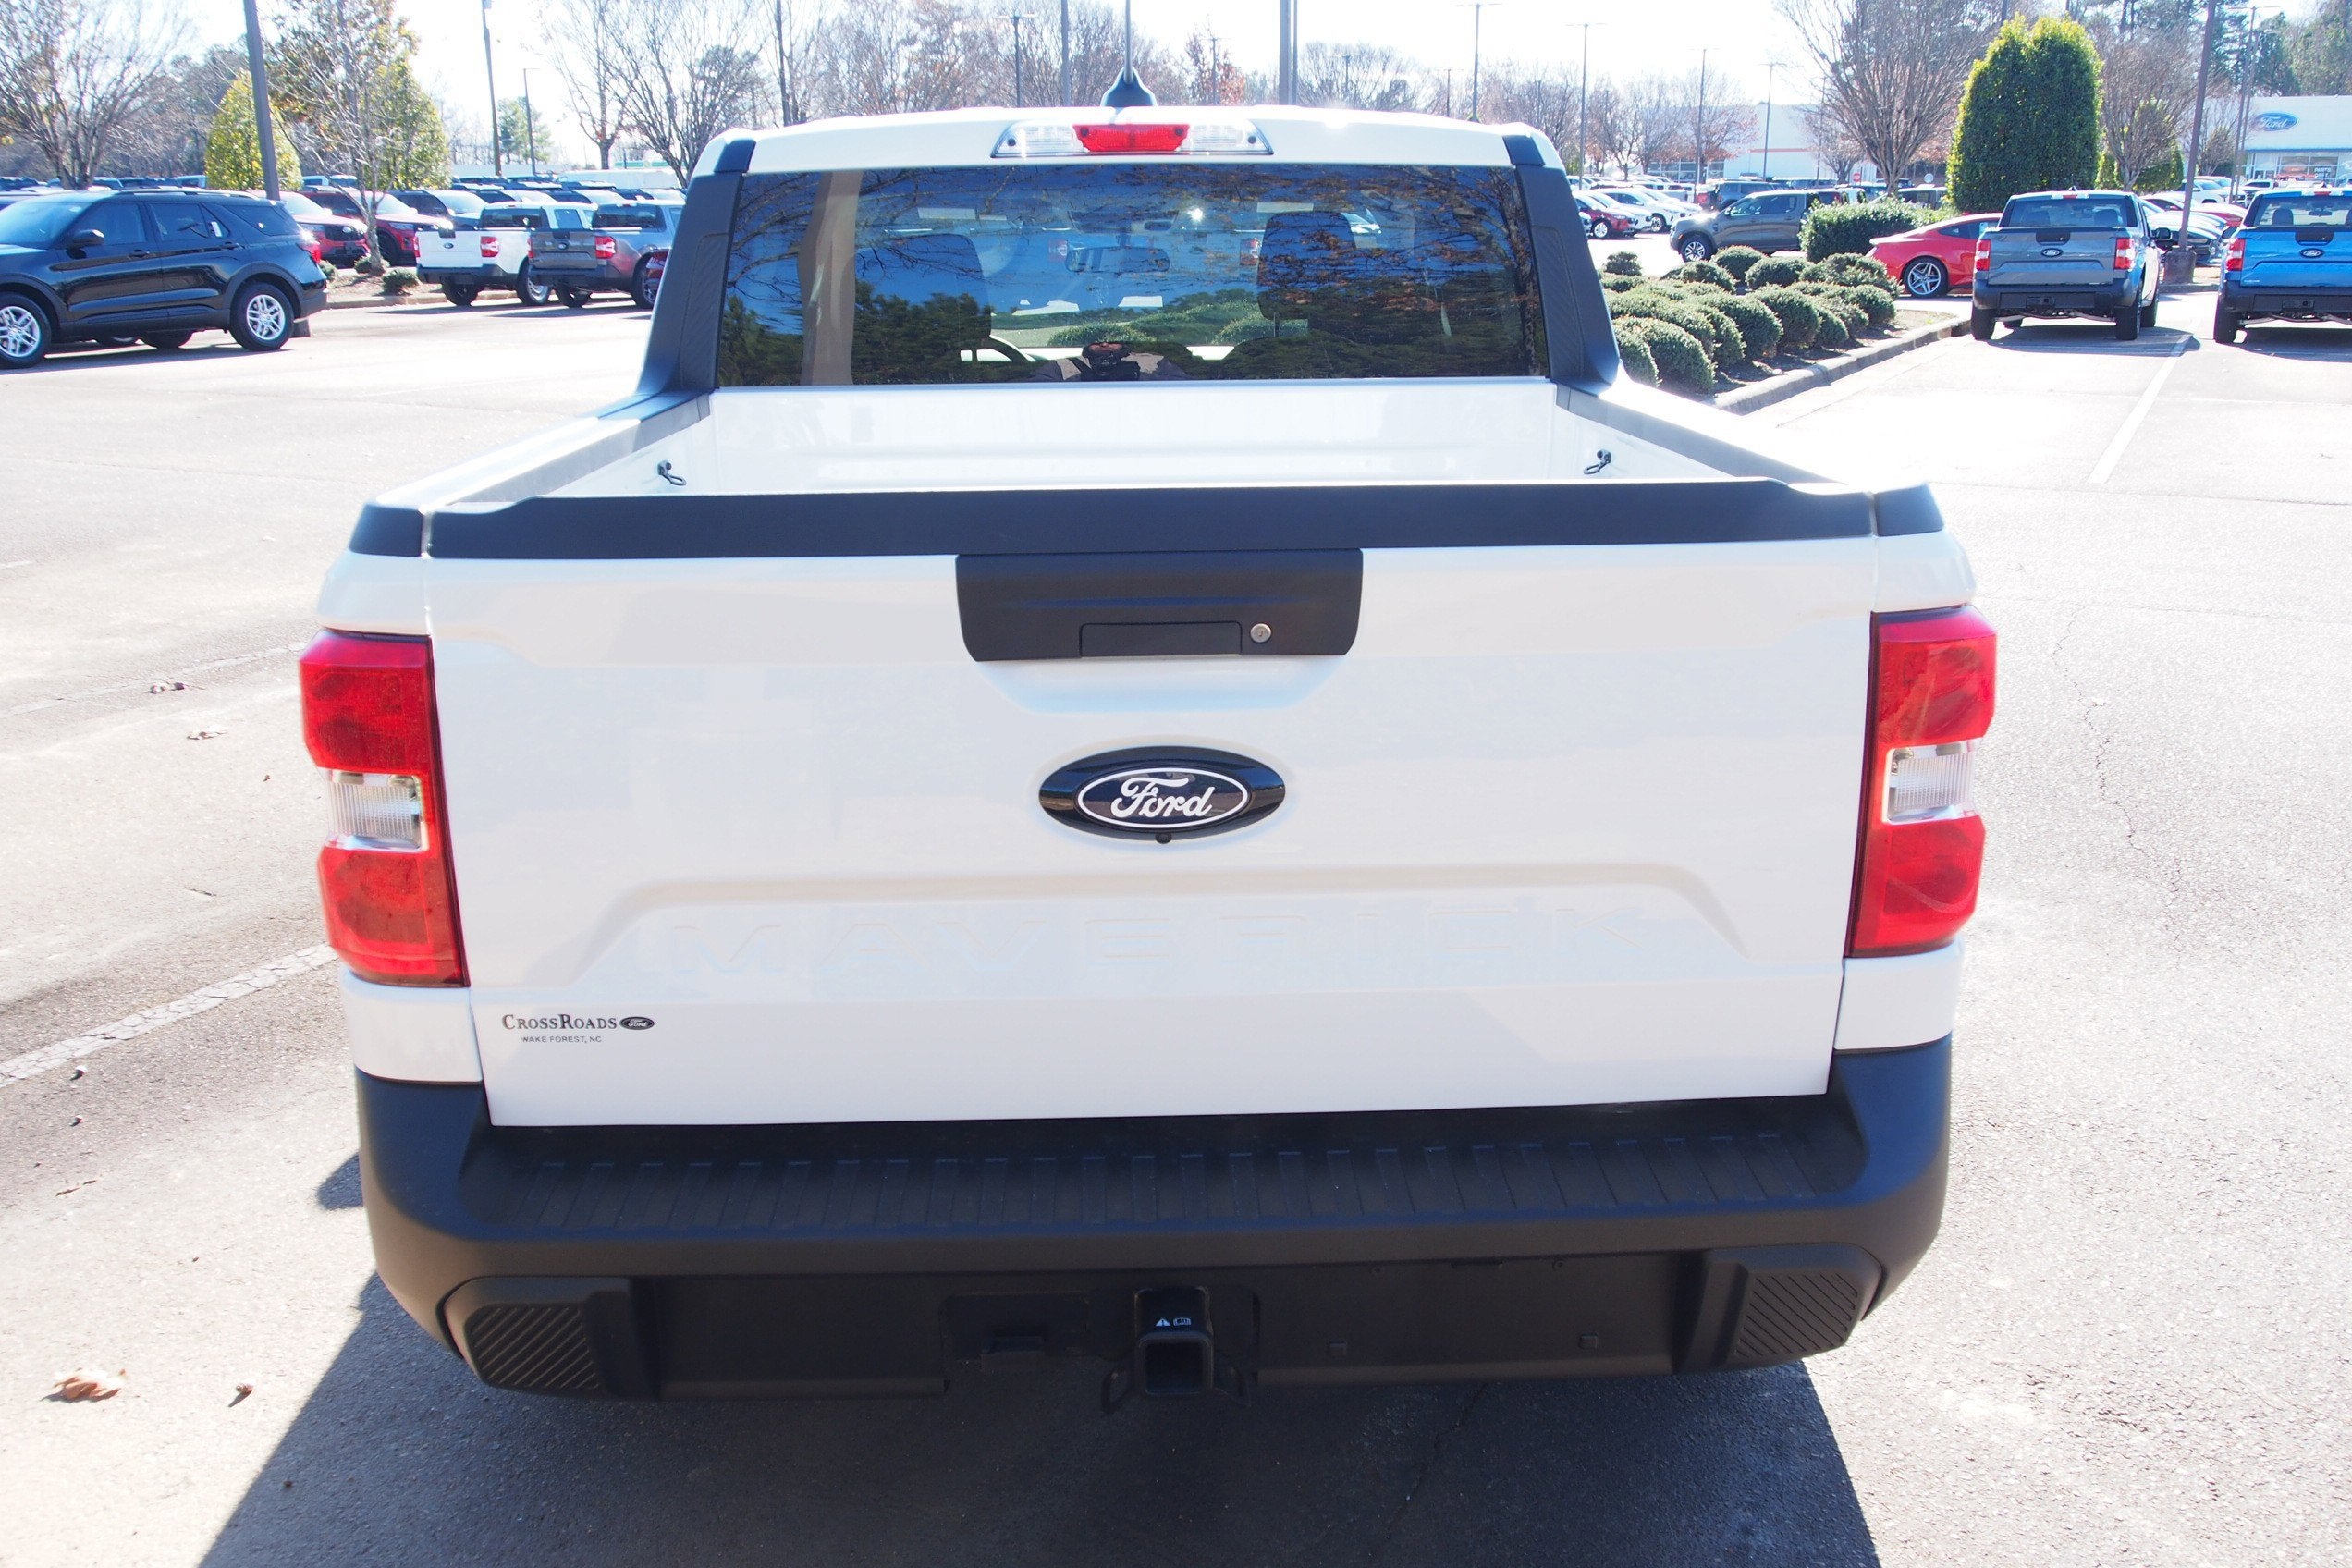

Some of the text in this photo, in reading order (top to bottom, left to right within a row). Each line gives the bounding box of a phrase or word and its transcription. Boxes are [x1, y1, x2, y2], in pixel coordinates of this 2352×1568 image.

[1110, 777, 1215, 817] Ford
[672, 906, 1645, 976] MAVERICK
[550, 1035, 587, 1044] FOREST,
